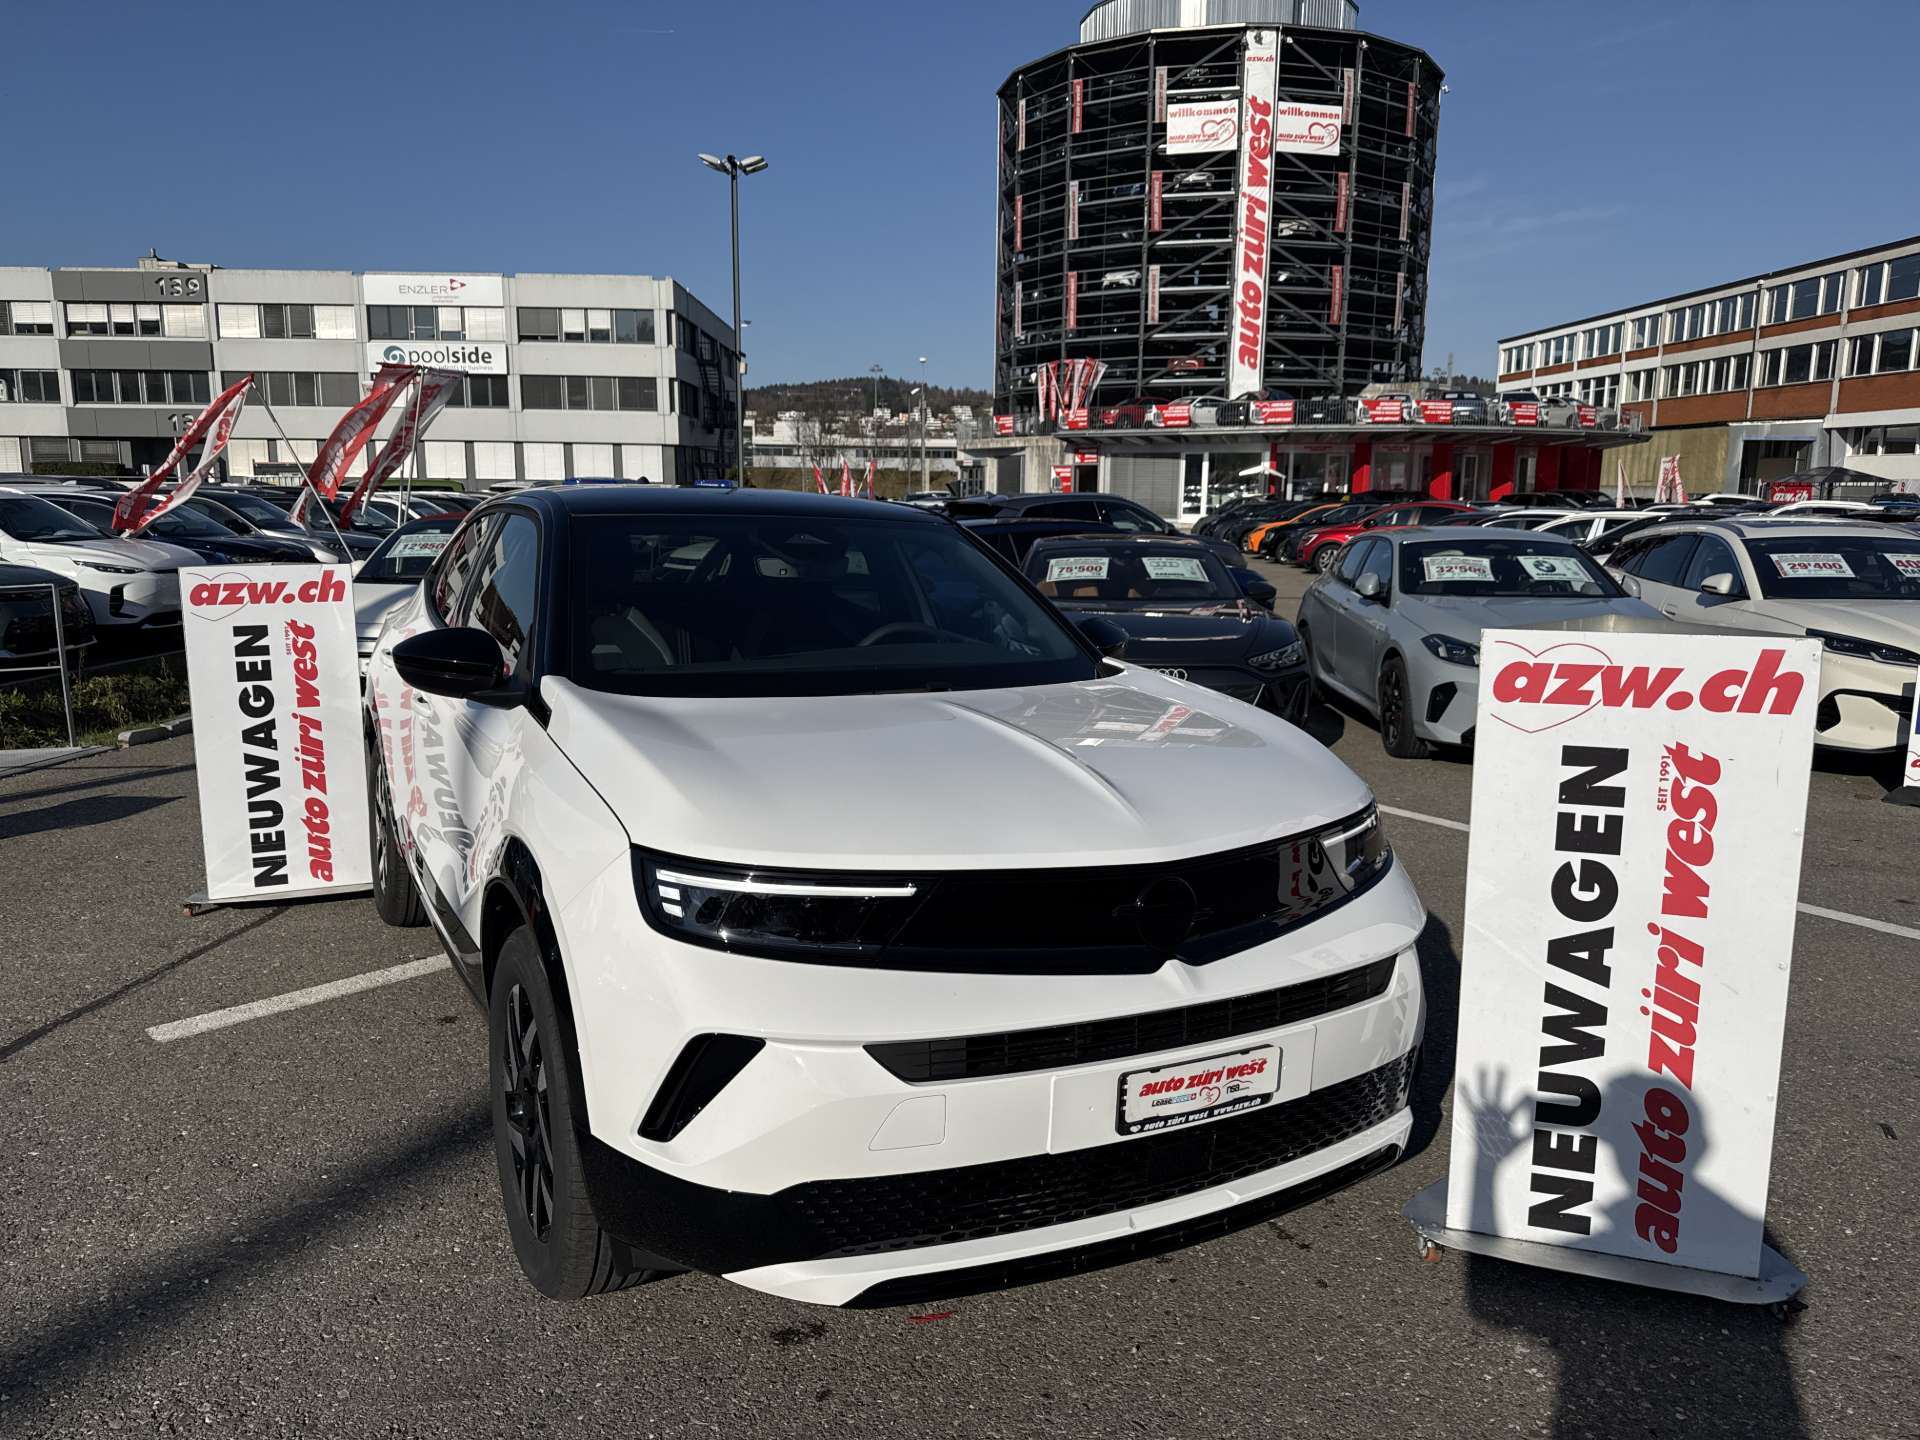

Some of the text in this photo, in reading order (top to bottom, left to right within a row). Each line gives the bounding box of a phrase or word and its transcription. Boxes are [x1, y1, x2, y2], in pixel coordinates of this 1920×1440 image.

[1169, 106, 1236, 118] willkommen
[1279, 107, 1340, 120] willkommen
[1237, 95, 1272, 370] auto züri west
[155, 277, 200, 297] 139
[398, 284, 448, 295] ENZLER
[409, 346, 492, 366] poolside
[1773, 489, 1809, 503] azw.ch
[1058, 565, 1103, 574] 75'500
[1787, 562, 1843, 570] 29'400
[190, 570, 346, 607] azw.ch
[1492, 649, 1805, 716] azw.ch
[232, 624, 289, 888] NEUWAGEN
[284, 619, 334, 882] auto züri west
[1656, 755, 1671, 811] SEIT 1991
[1527, 744, 1630, 1236] NEUWAGEN
[1630, 740, 1722, 1254] auto züri west
[1139, 1057, 1268, 1098] auto züri west
[1143, 1097, 1262, 1131] auto züri west www.azw.ch
